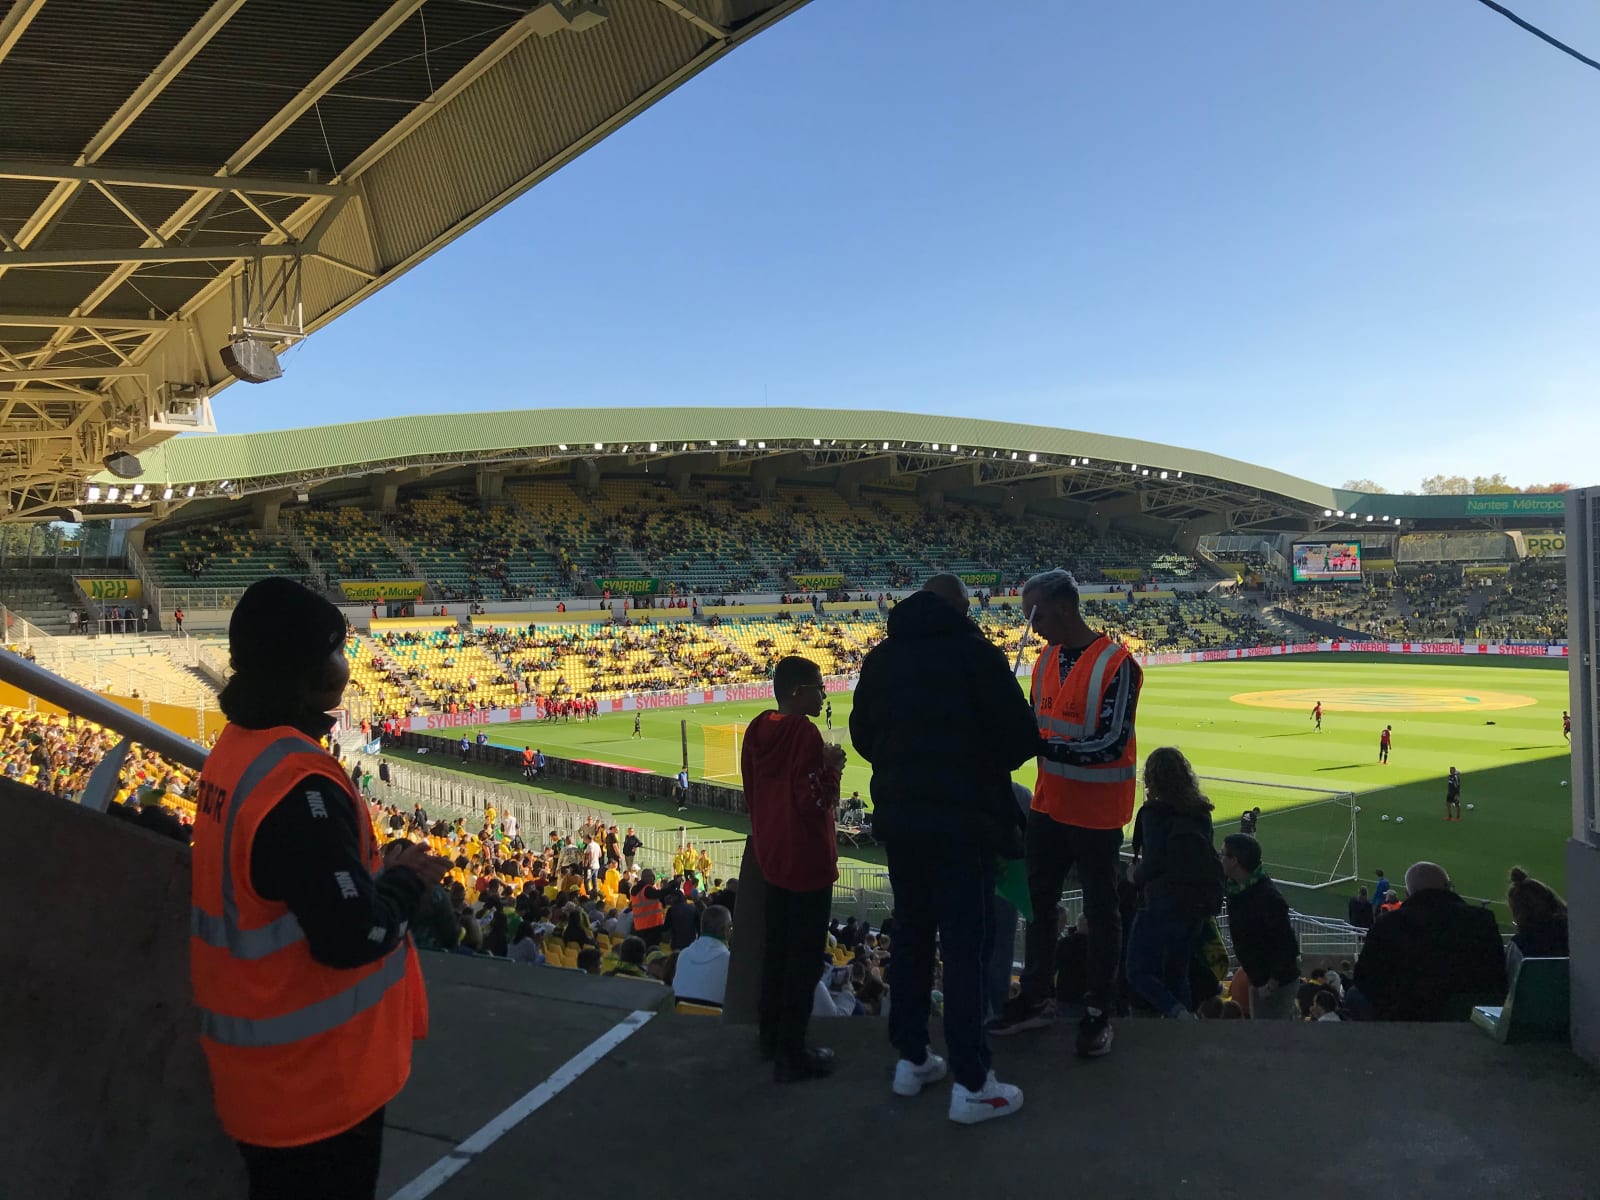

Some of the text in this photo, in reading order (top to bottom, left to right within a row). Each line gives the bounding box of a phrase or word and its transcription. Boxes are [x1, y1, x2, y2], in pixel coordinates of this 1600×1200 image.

[1468, 500, 1508, 510] Nantes
[1528, 538, 1565, 550] PRO
[602, 580, 652, 591] SYNERGIE
[806, 577, 842, 587] NANTES
[92, 581, 128, 598] N2H
[345, 586, 422, 597] Crédit Mutuel
[1350, 642, 1389, 652] SYNERGIE
[1421, 643, 1464, 654] SYNERGIE
[1499, 644, 1546, 656] SYNERGIE
[726, 686, 773, 702] SYNERGIE
[636, 692, 688, 710] SYNERGIE
[427, 710, 490, 730] SYNERGIE
[305, 790, 328, 818] NIKE
[334, 871, 359, 899] NIKE
